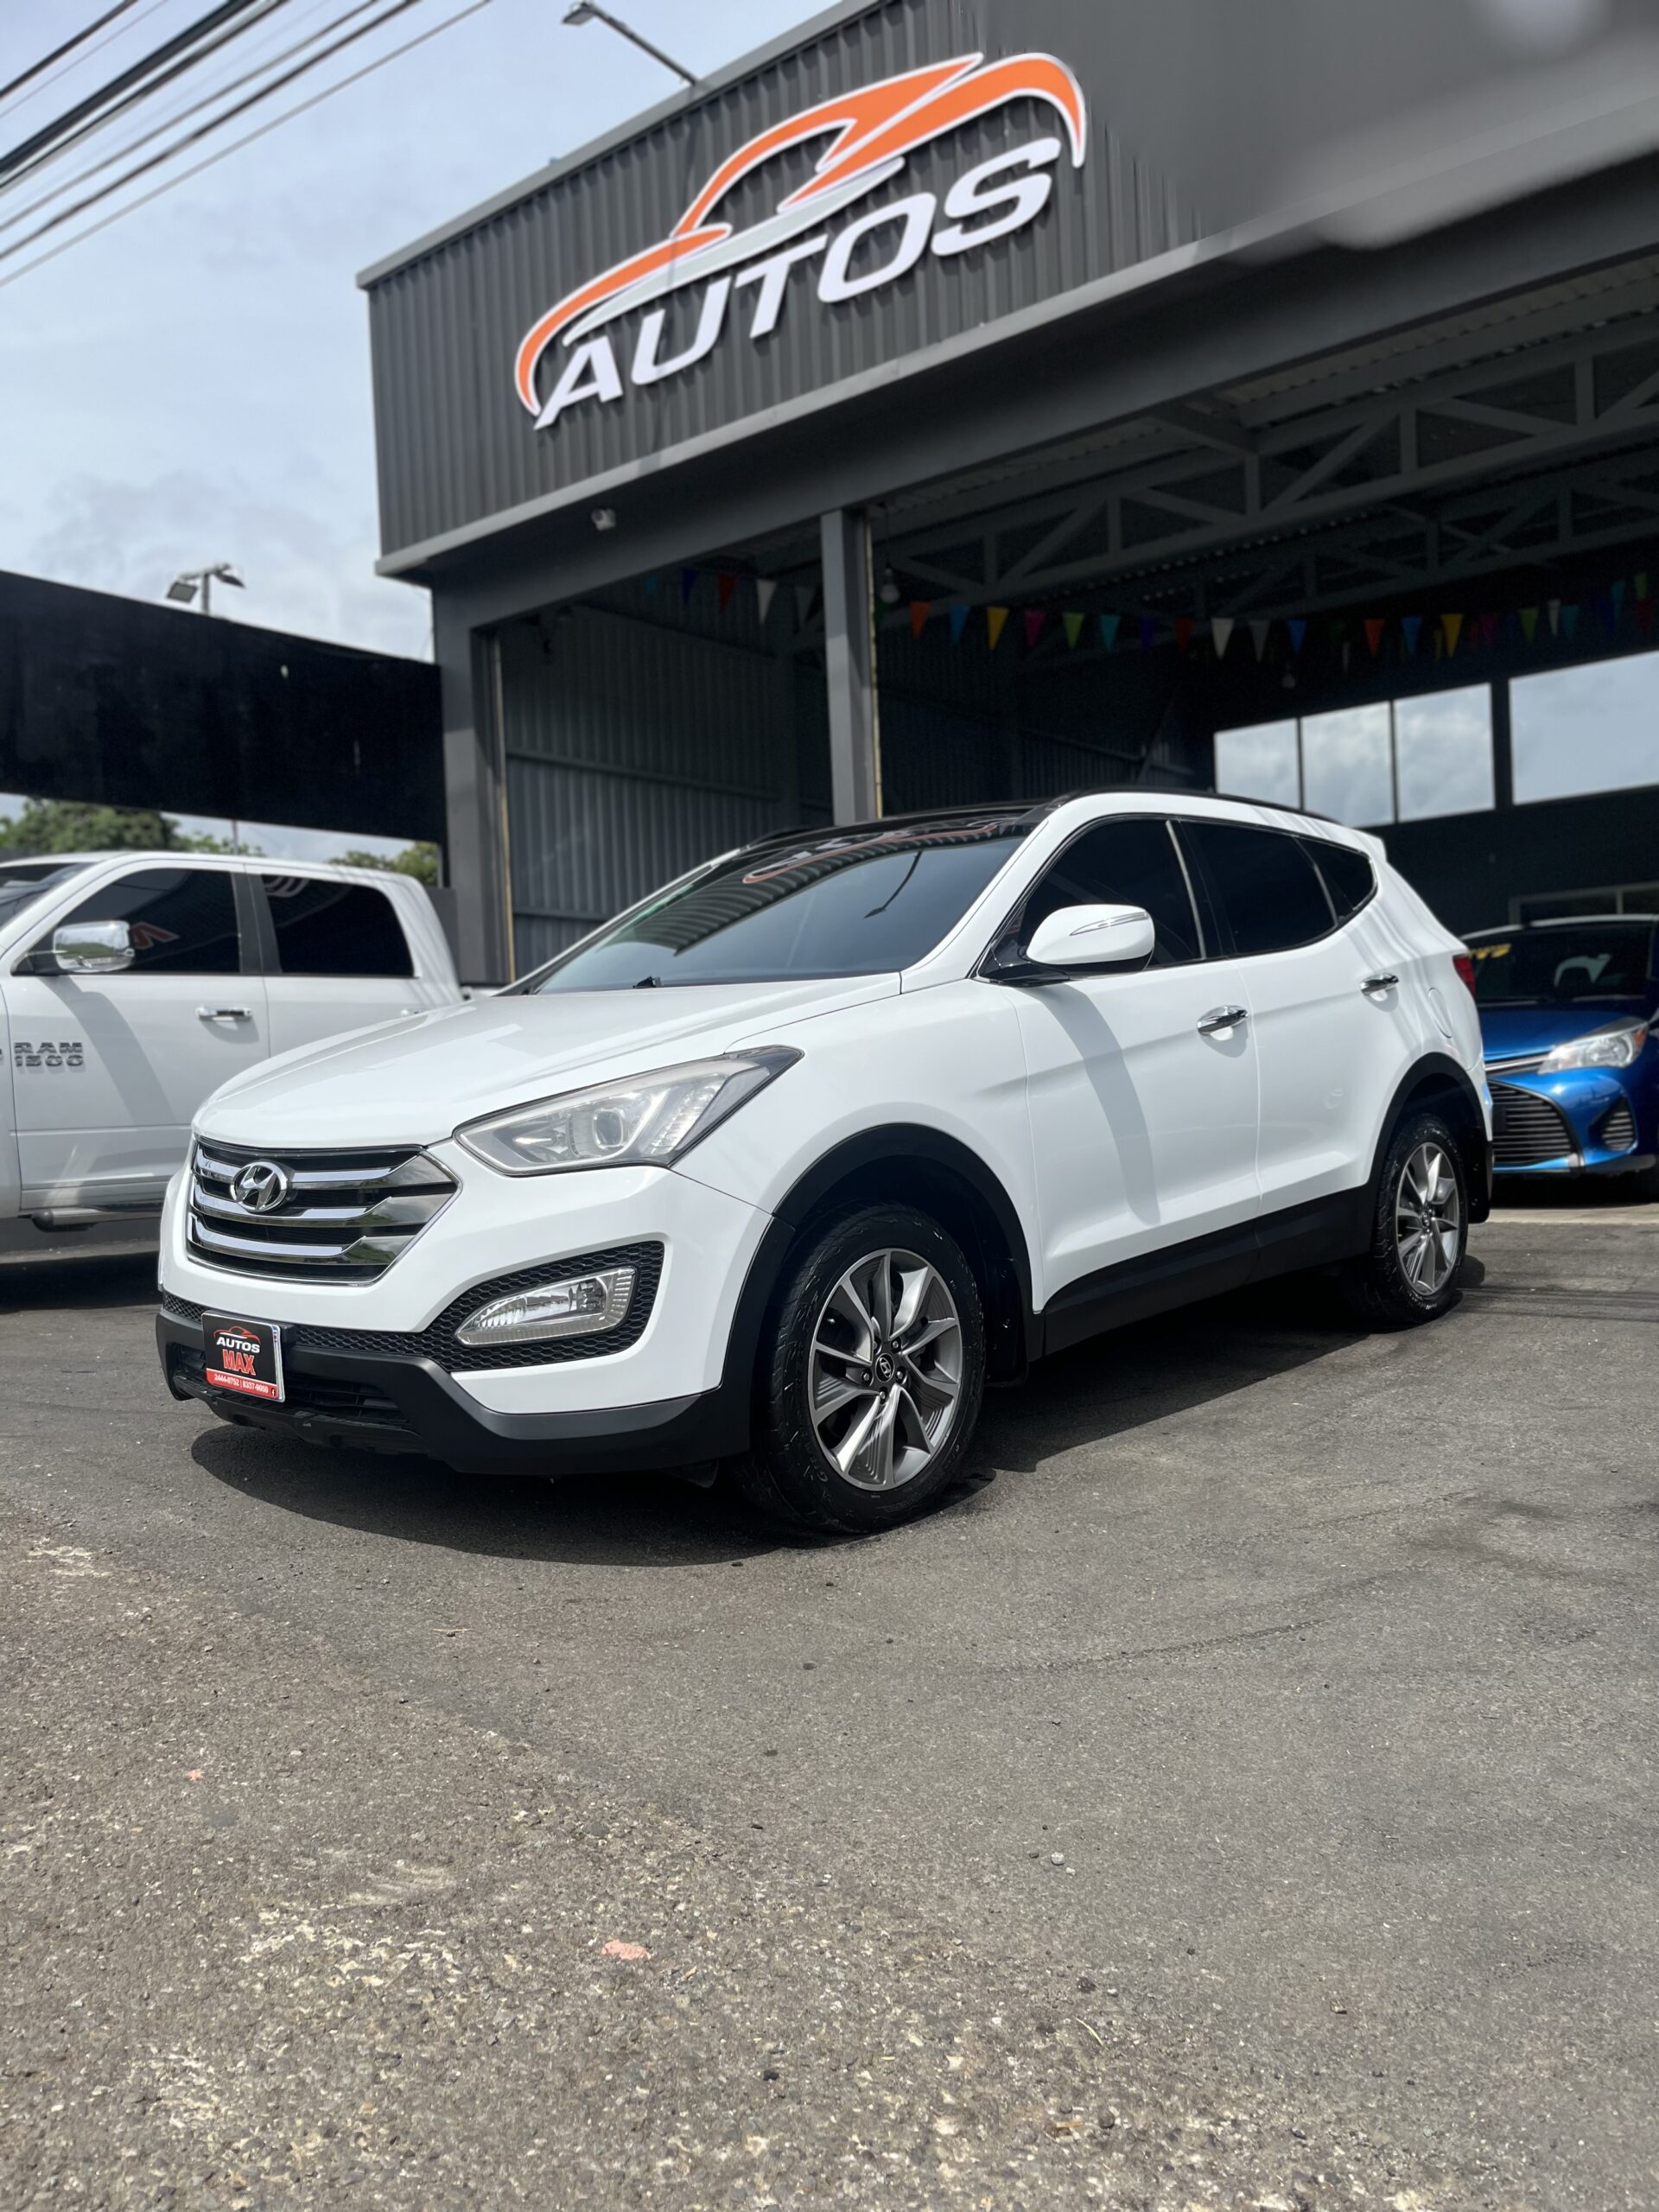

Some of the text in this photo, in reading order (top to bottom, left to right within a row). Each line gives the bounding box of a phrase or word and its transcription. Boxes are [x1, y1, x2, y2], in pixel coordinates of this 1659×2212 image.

[534, 137, 1062, 430] AUTOS
[14, 1042, 83, 1054] RAM
[15, 1055, 84, 1067] 1500
[216, 1337, 261, 1354] AUTOS
[222, 1349, 257, 1376] MAX
